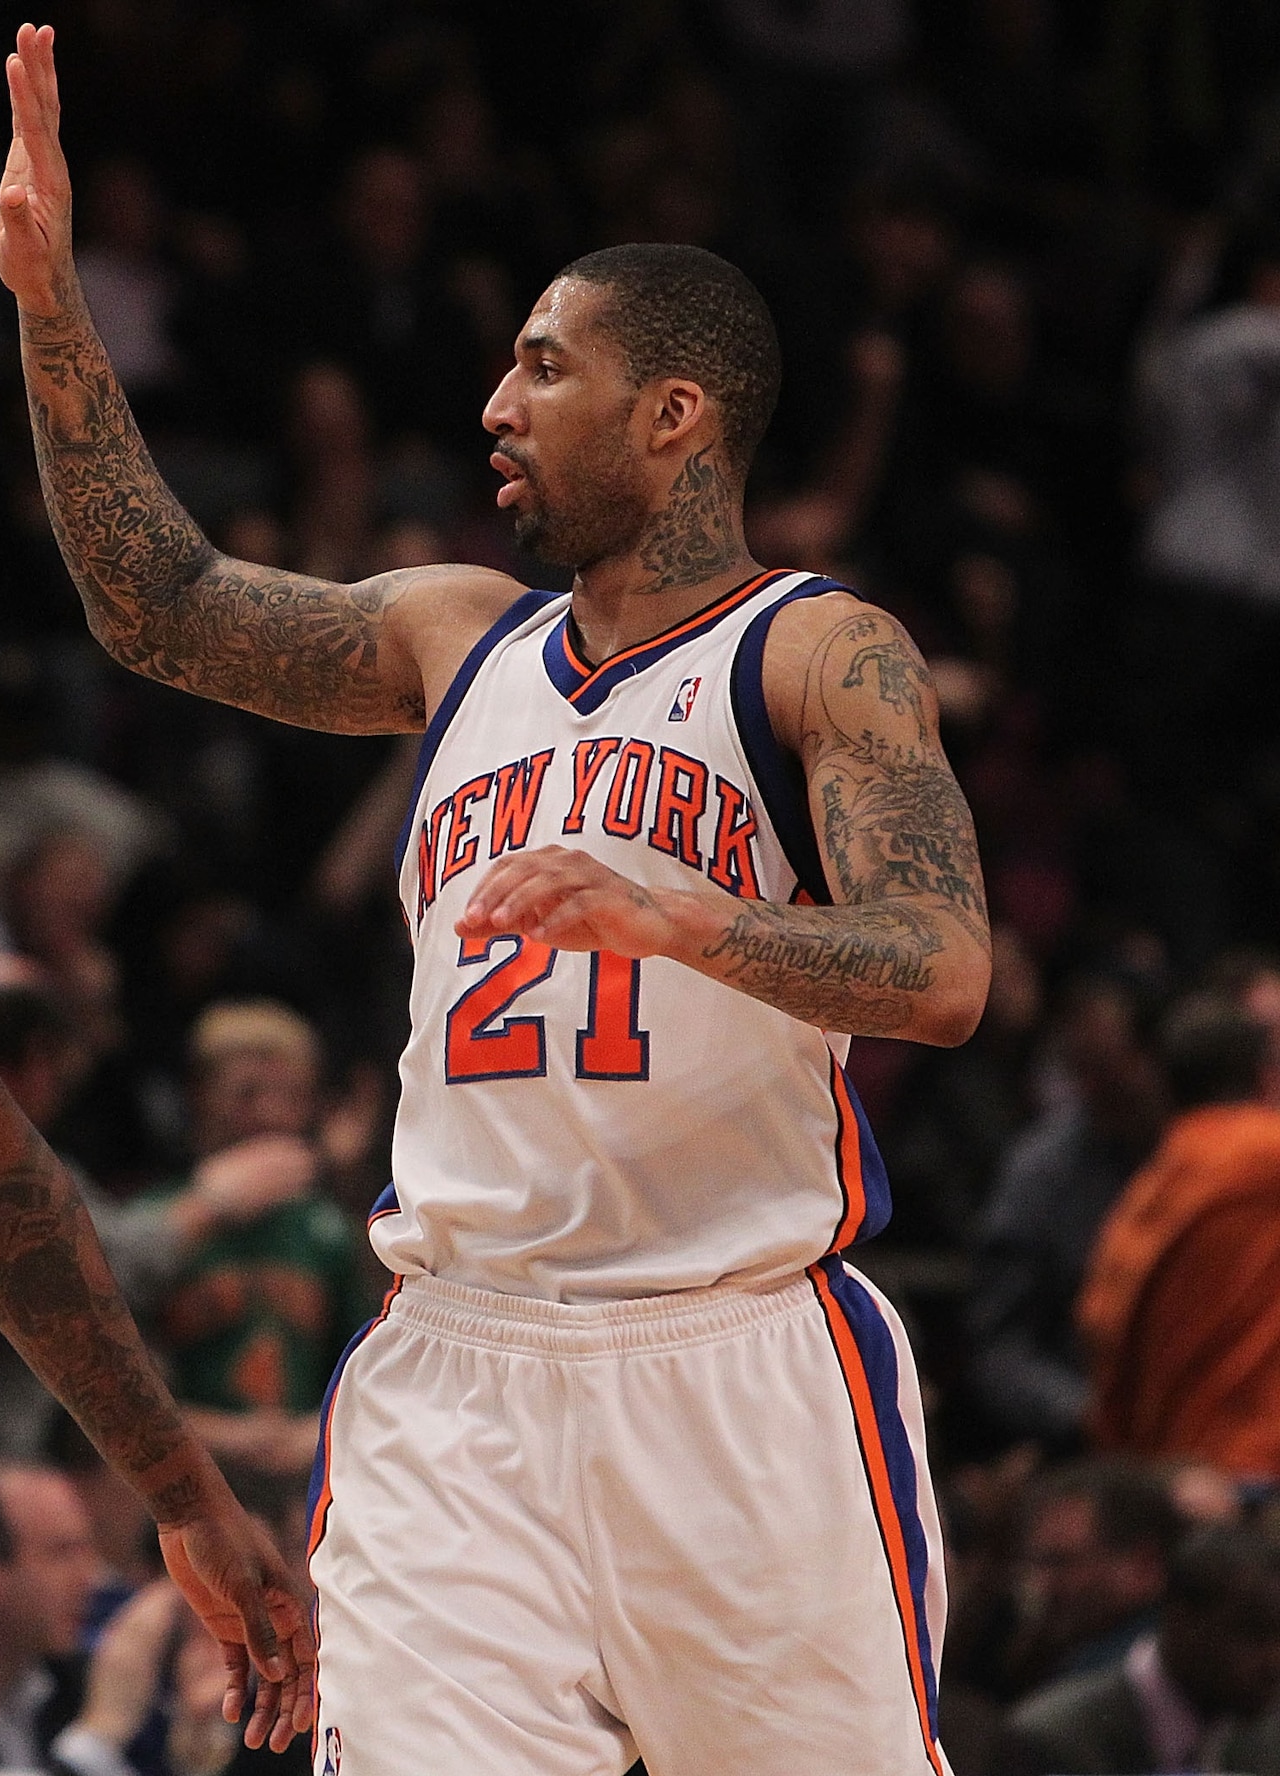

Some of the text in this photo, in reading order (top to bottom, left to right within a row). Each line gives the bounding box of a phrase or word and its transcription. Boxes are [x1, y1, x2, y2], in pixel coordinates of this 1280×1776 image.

[417, 747, 556, 932] NEW
[562, 736, 767, 902] YORK
[445, 933, 651, 1086] 21
[702, 913, 832, 981] Against
